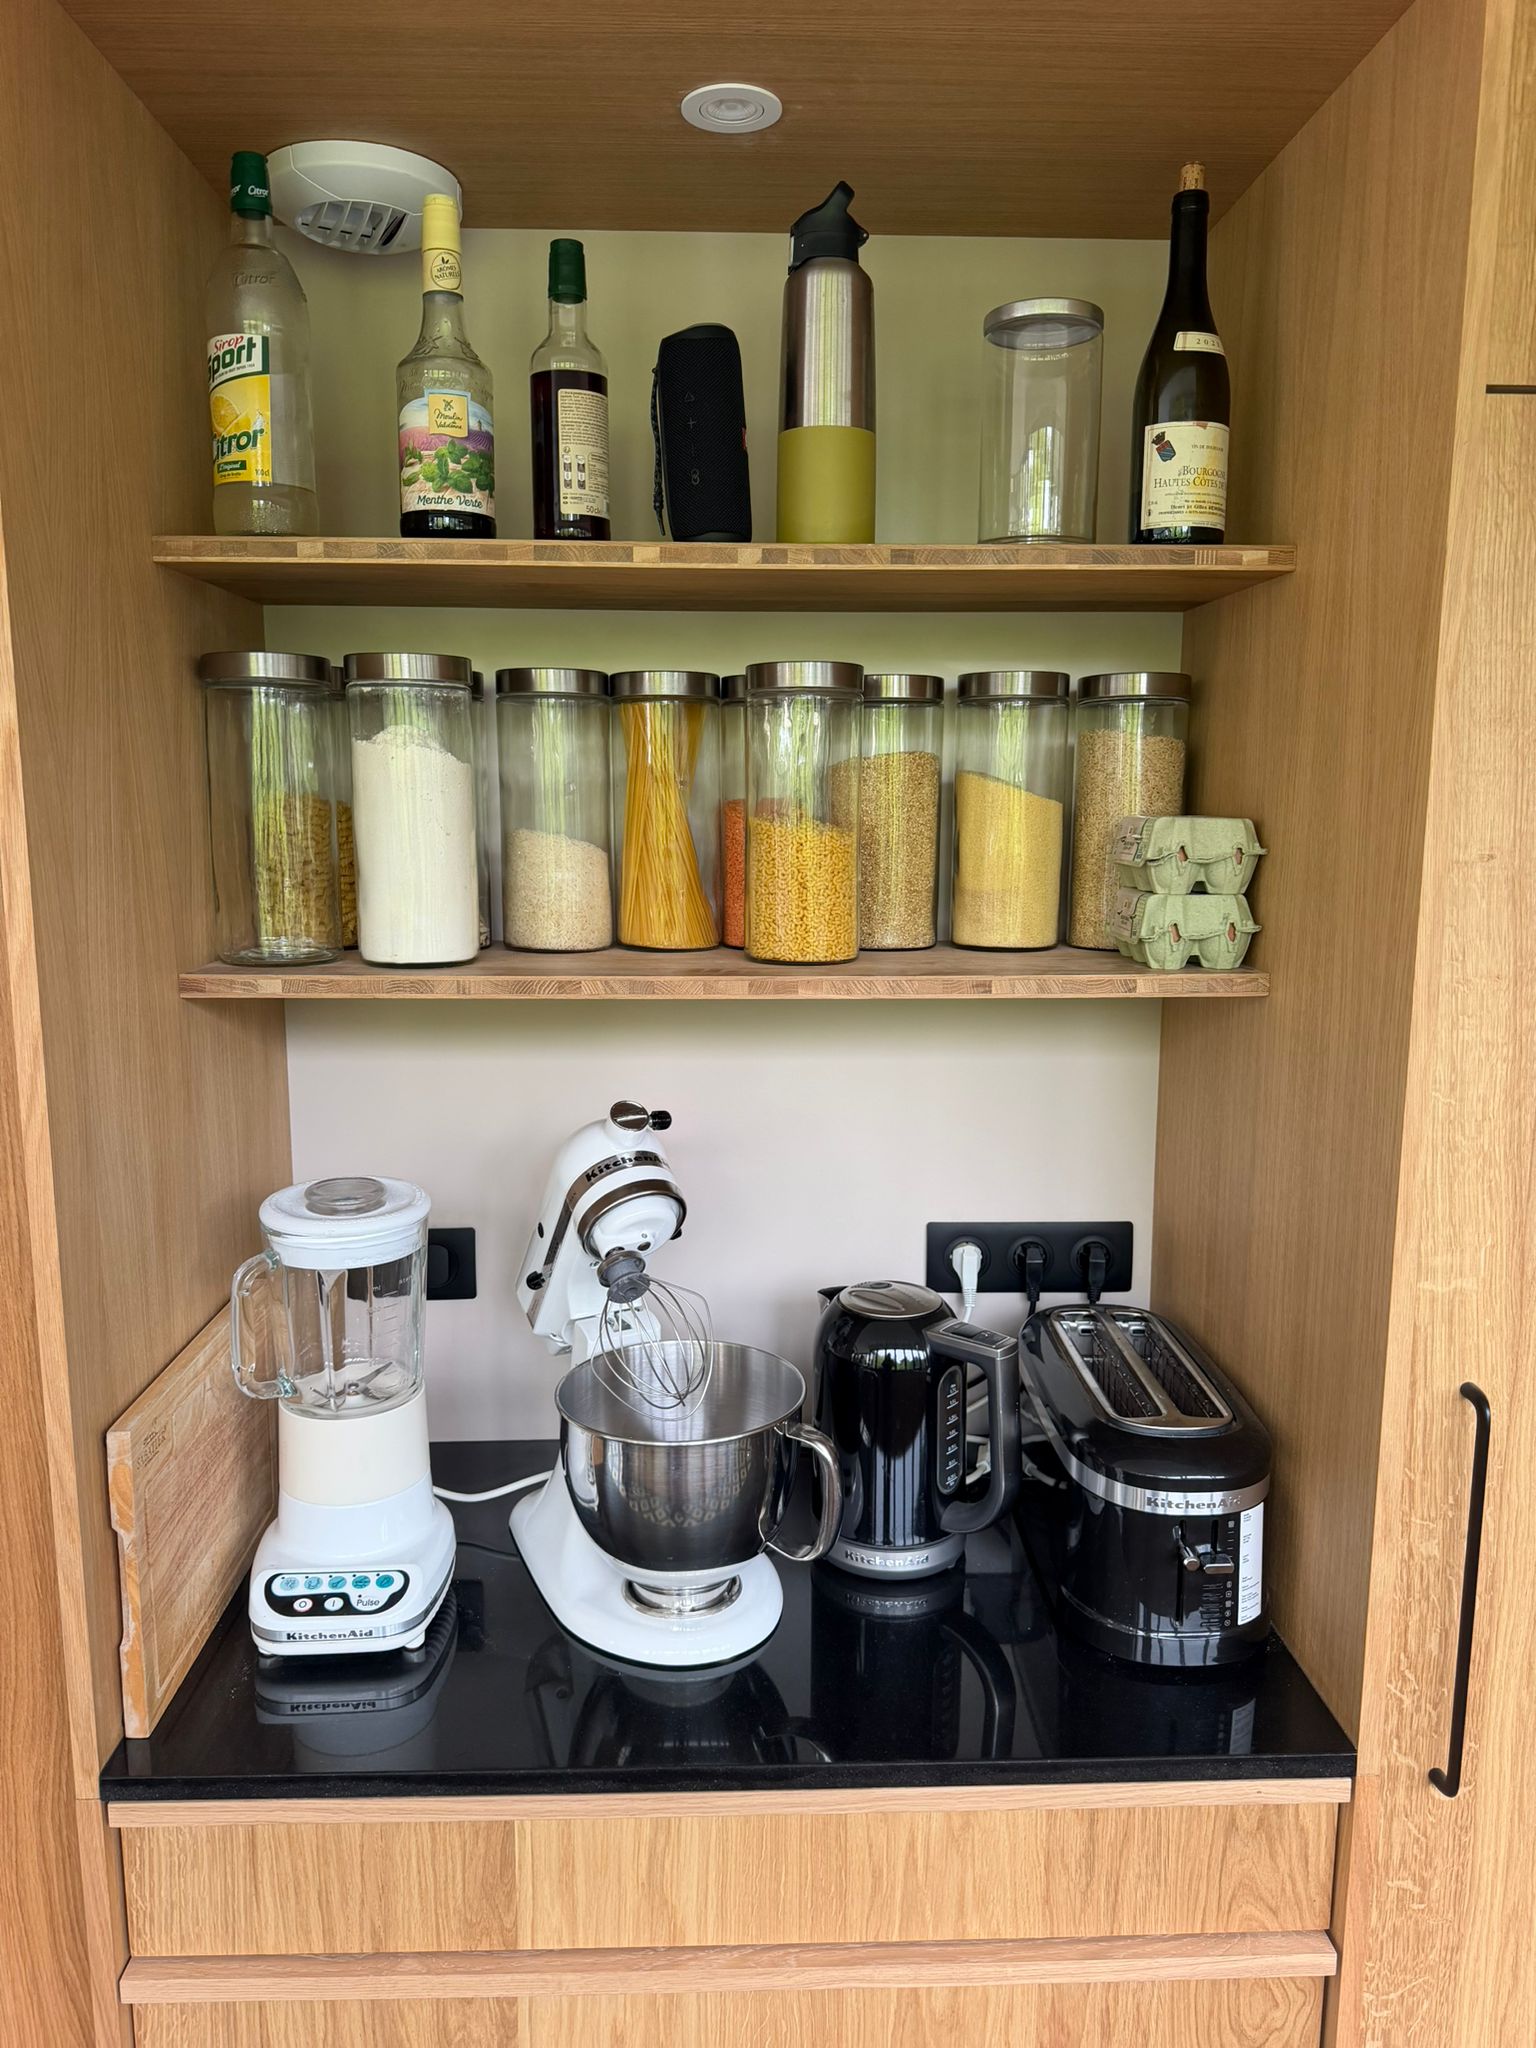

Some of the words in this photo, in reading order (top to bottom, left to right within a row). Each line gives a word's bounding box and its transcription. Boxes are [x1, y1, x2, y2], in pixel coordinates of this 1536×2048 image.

[214, 335, 244, 355] Sirop
[212, 428, 265, 462] itror
[1153, 478, 1191, 489] HAUTES
[417, 495, 453, 506] Menthe
[456, 495, 483, 508] Verte
[585, 1155, 666, 1182] KitchenA
[1146, 1495, 1241, 1510] KitchenAid
[845, 1549, 929, 1568] KitchenAid
[356, 1598, 380, 1608] Pulse
[286, 1628, 374, 1641] KitchenAid
